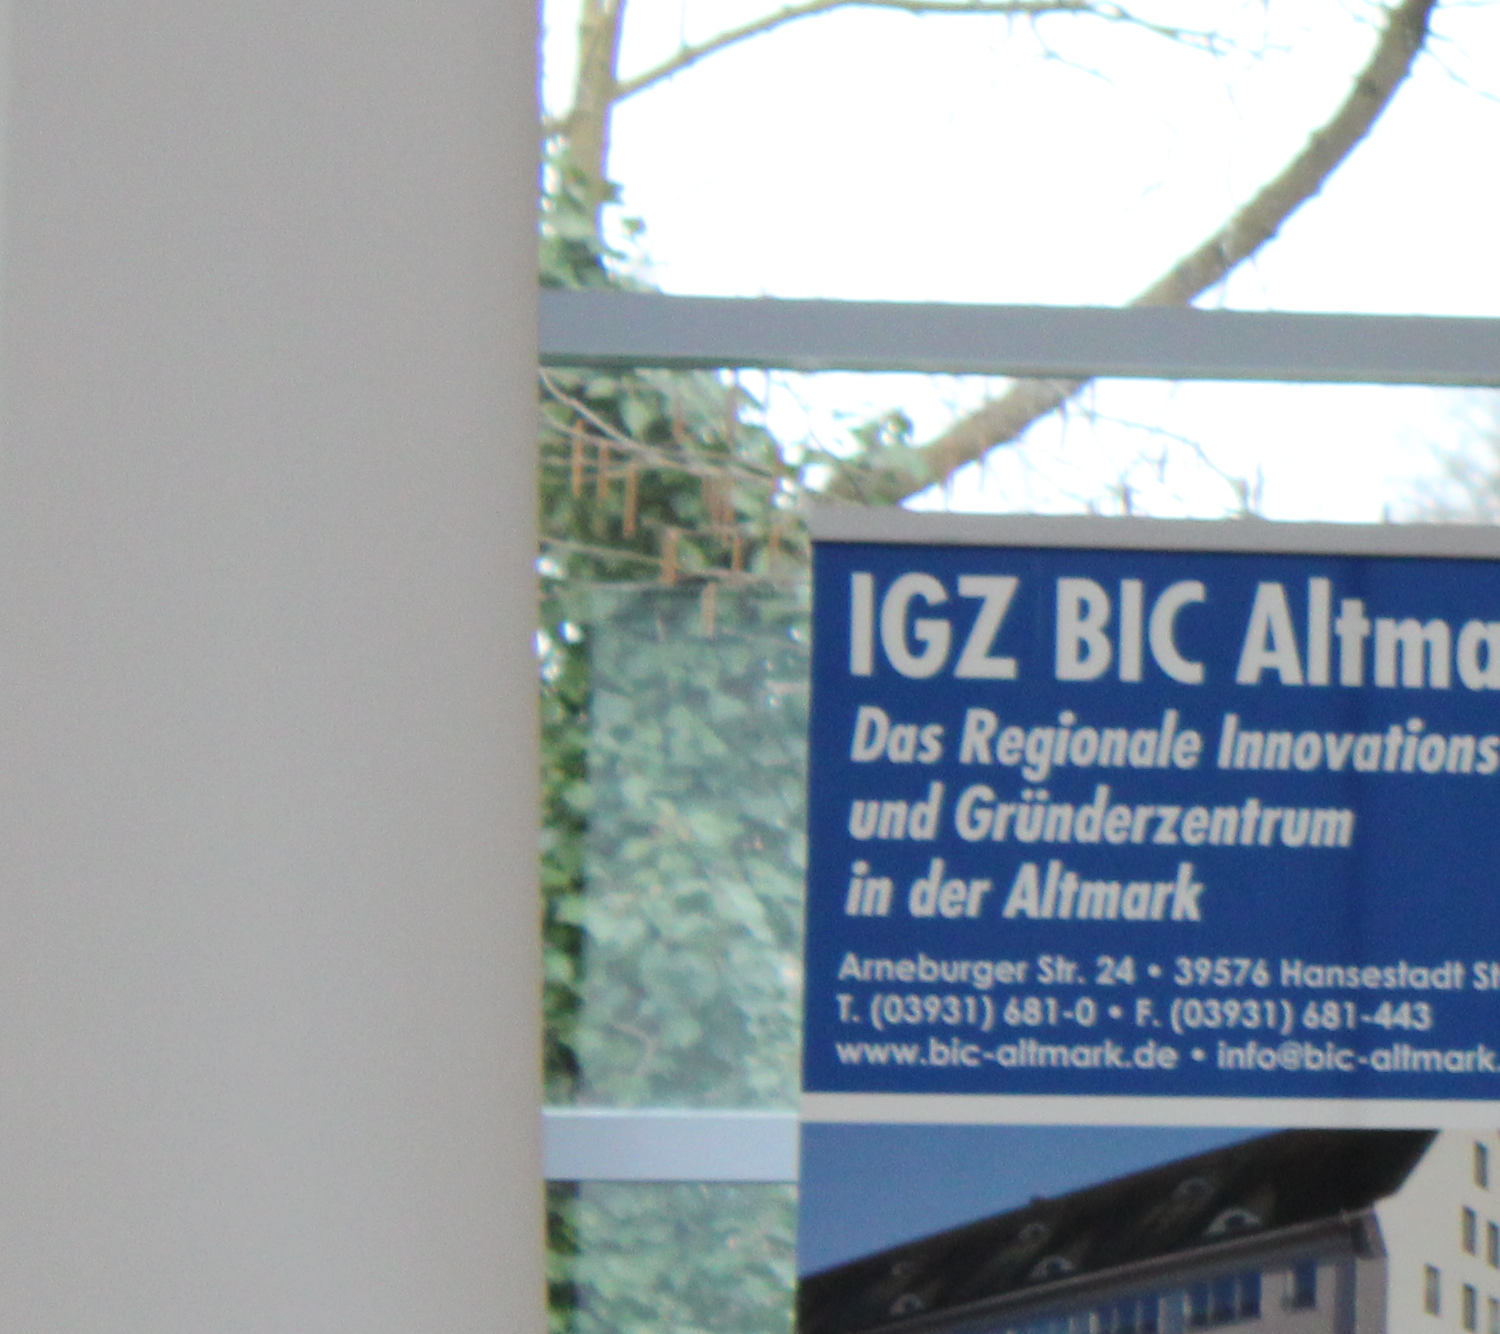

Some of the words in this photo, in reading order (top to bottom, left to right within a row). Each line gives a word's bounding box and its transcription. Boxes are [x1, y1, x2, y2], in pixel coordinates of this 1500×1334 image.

[849, 572, 1019, 682] IGZ
[1054, 578, 1206, 685] BIC
[850, 705, 943, 766] Das
[960, 709, 1201, 781] Regionale
[848, 788, 940, 842] und
[954, 786, 1354, 850] Gründerzentrum
[846, 862, 893, 917] in
[908, 864, 991, 921] der
[1002, 864, 1203, 924] Altmark
[837, 951, 1029, 990] Arneburger
[1036, 954, 1087, 984] Str.
[1095, 955, 1137, 986] 24
[1173, 956, 1271, 988] 39576
[1279, 958, 1465, 990] Hansestadt
[836, 993, 861, 1024] T.
[870, 993, 995, 1032] (03931)
[1003, 996, 1097, 1027] 681-0
[1135, 998, 1162, 1027] F.
[1170, 998, 1295, 1035] (03931)
[1302, 999, 1433, 1031] 681-443
[834, 1036, 1179, 1069] www.bic-altmark.de
